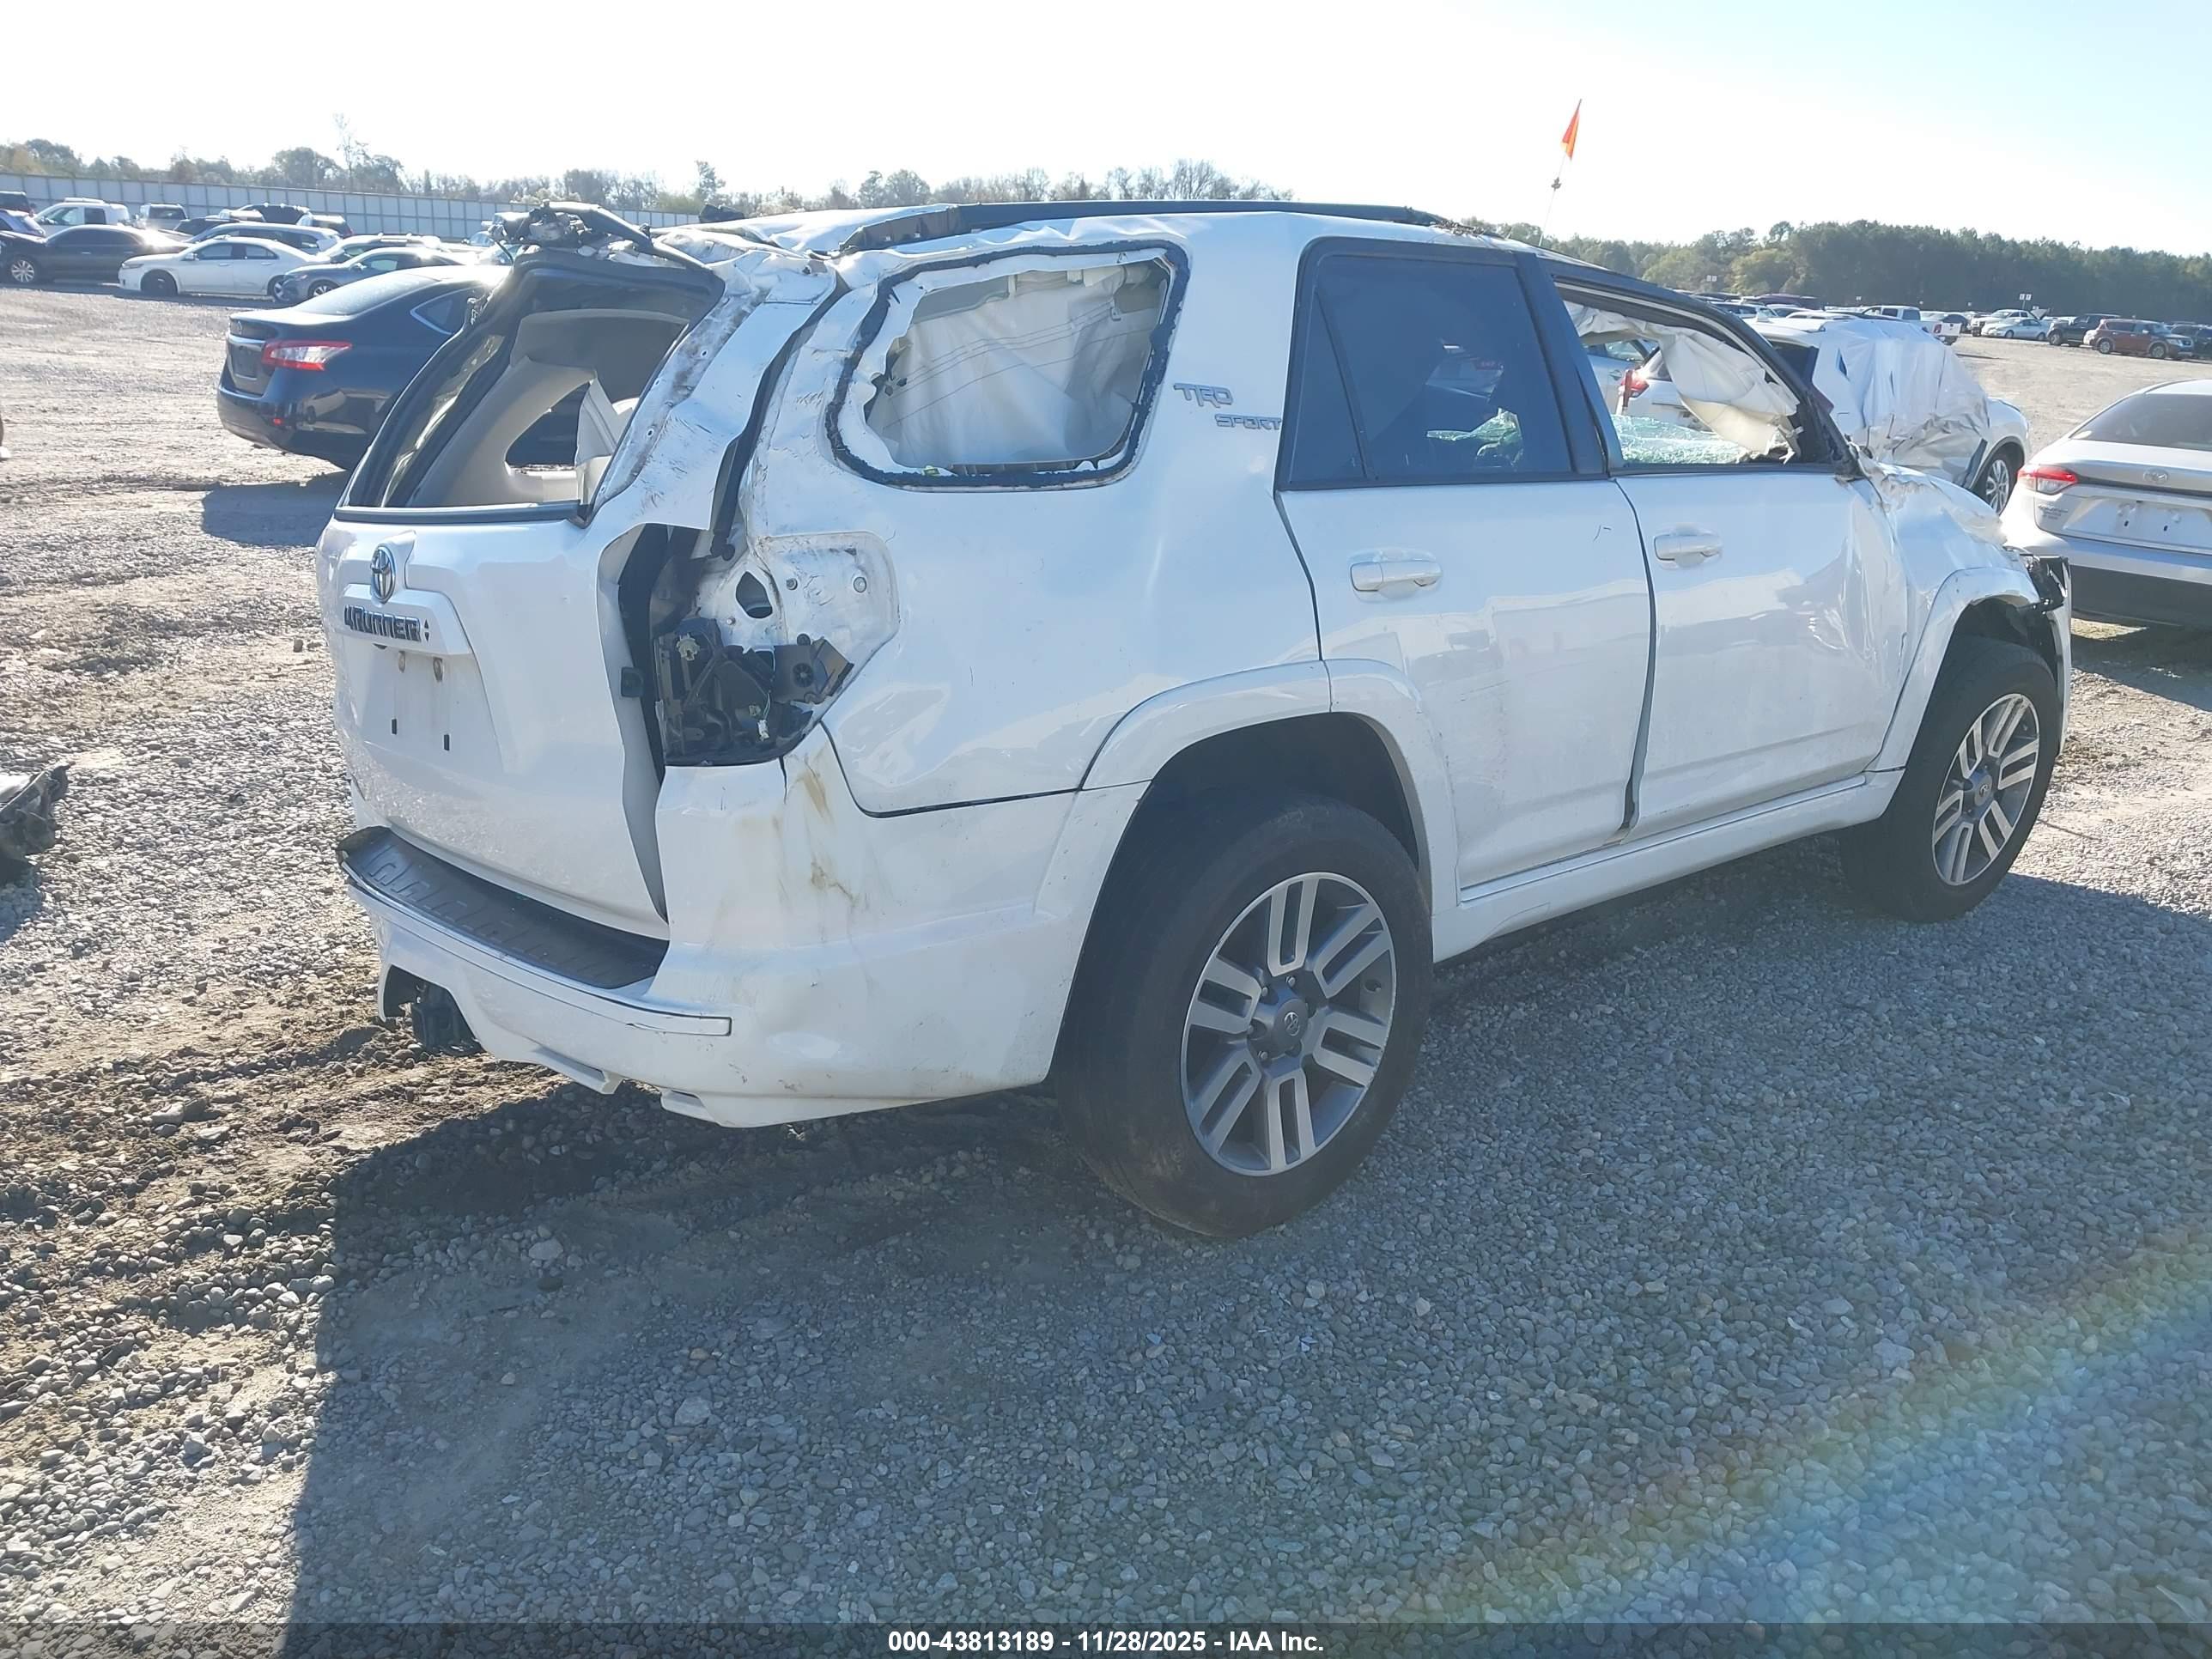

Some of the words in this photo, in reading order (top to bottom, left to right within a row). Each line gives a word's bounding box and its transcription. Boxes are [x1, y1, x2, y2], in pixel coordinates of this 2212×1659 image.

[1174, 383, 1233, 408] TRD
[1215, 414, 1282, 430] SPORT
[344, 605, 422, 641] 4RUNNER
